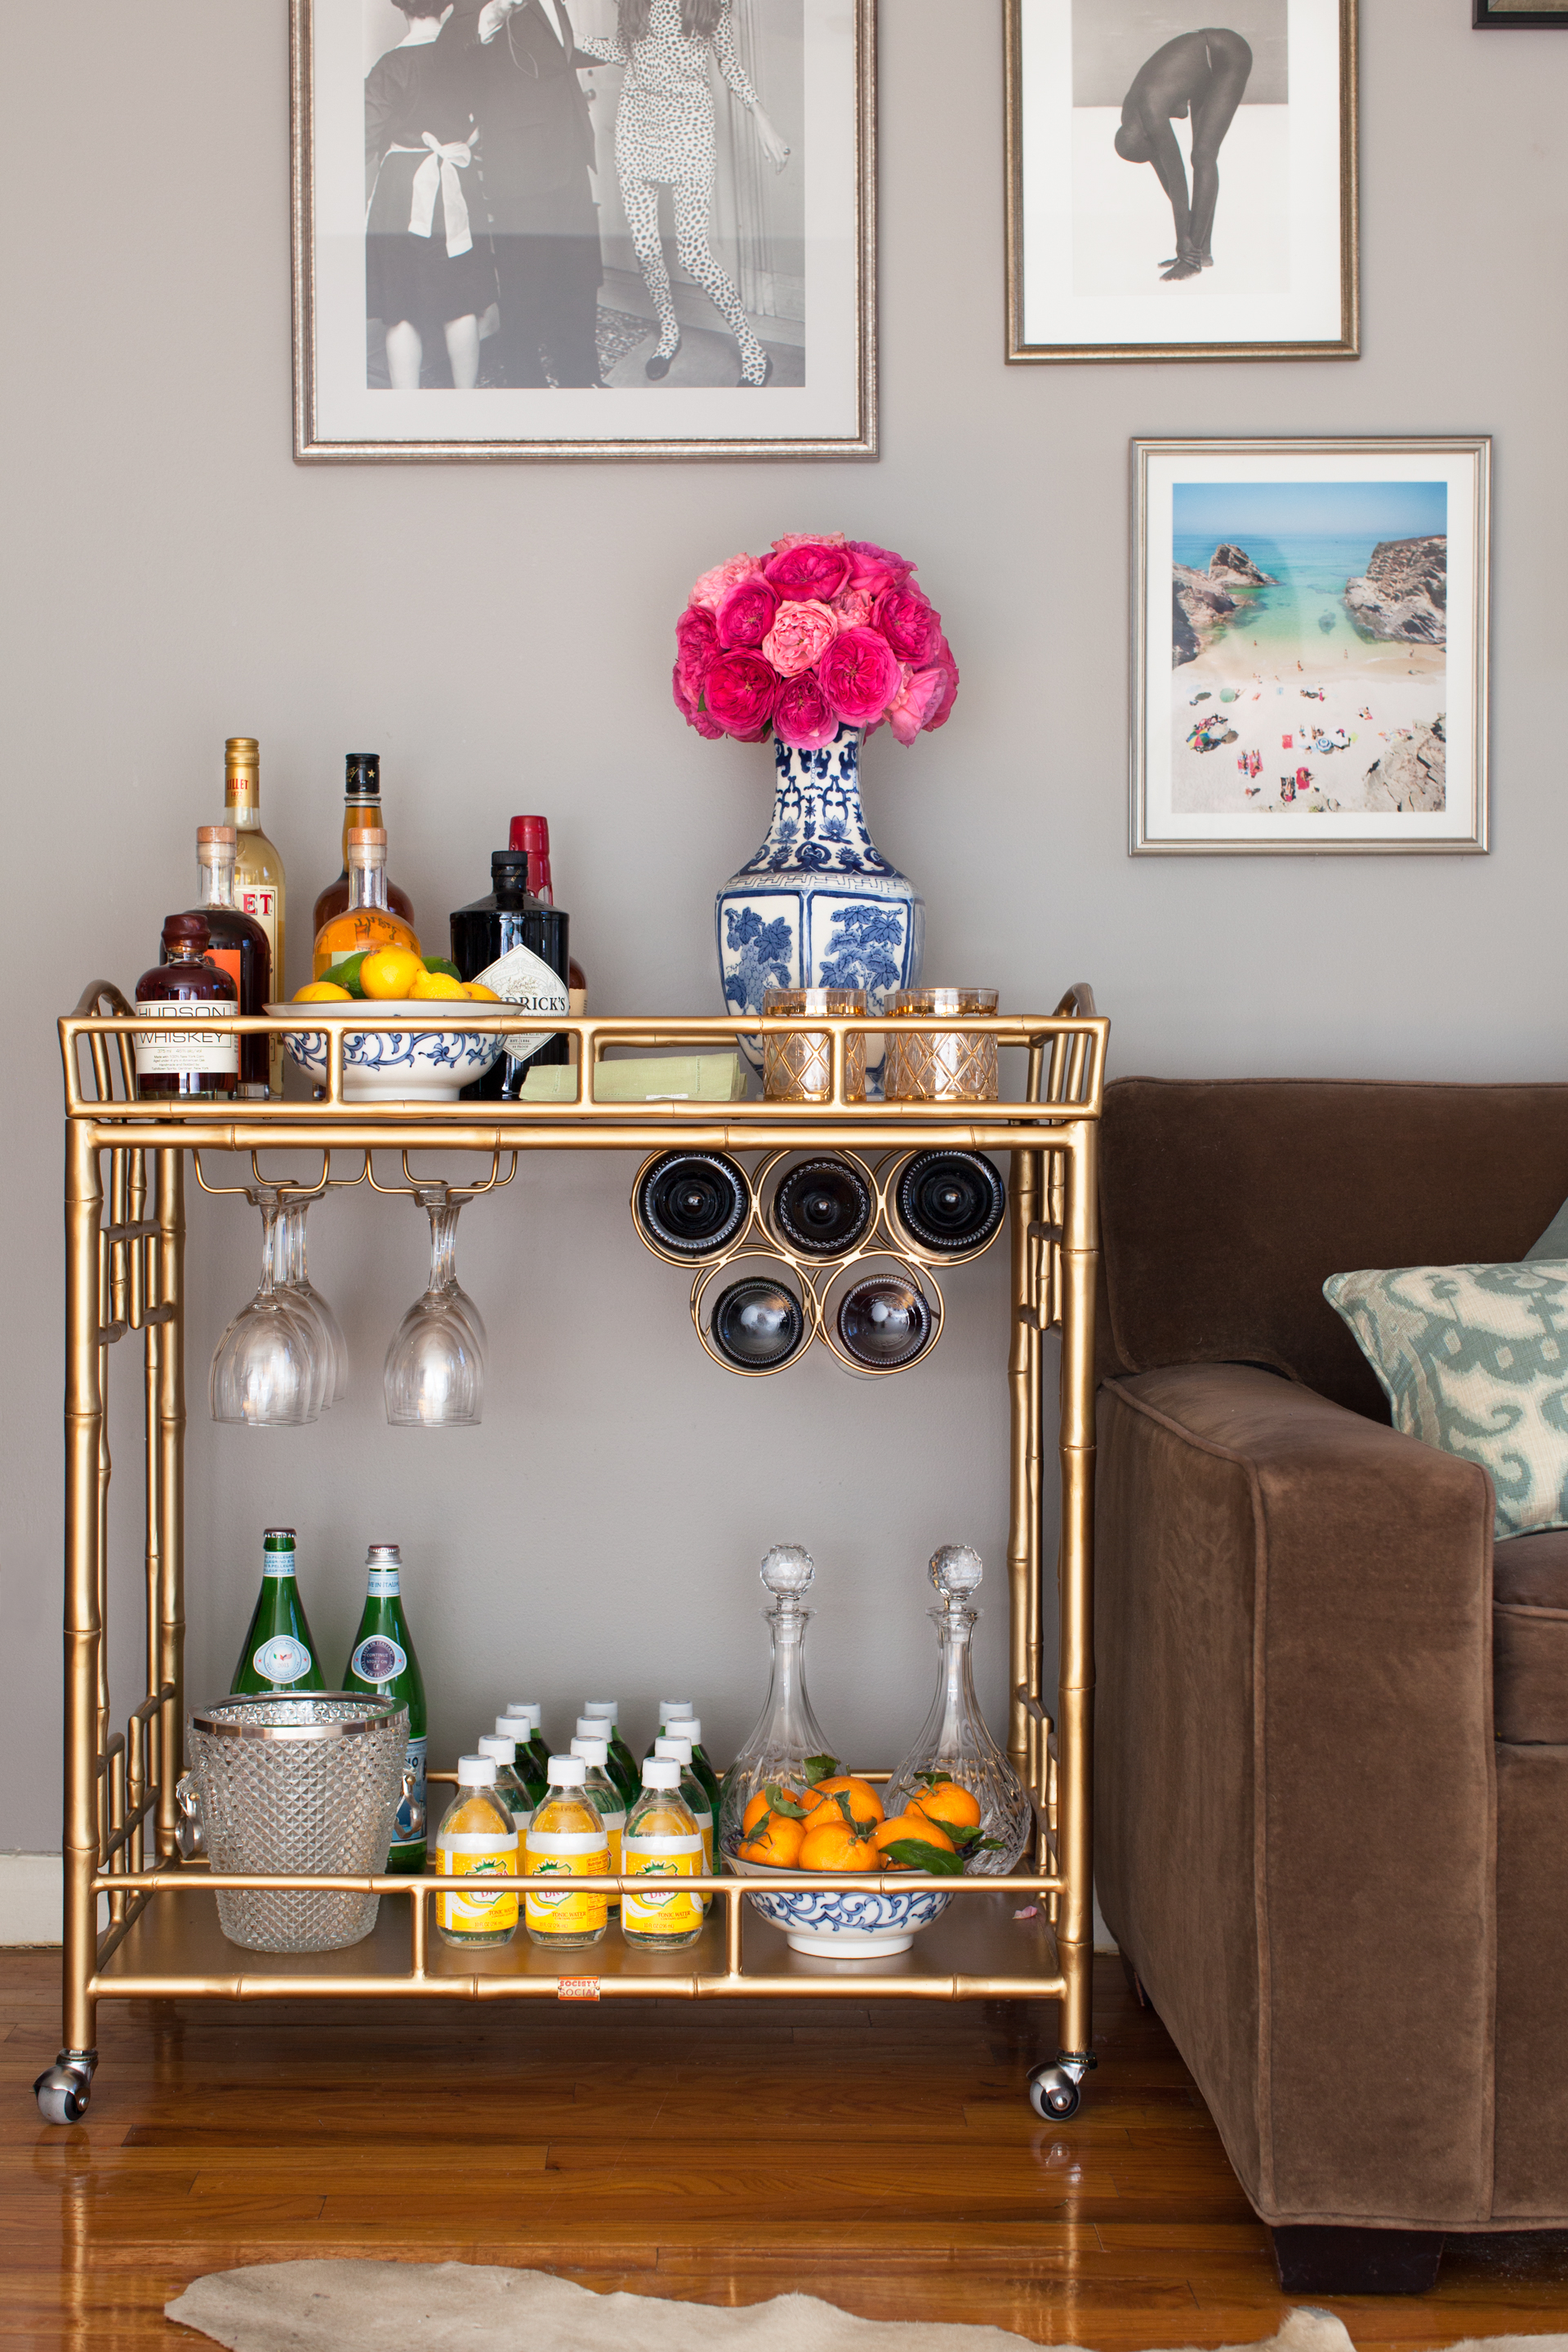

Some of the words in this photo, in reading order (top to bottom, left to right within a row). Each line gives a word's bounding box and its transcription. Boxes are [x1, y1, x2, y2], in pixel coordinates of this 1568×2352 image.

[242, 893, 274, 915] ET
[138, 1007, 225, 1017] HUDSON
[140, 1032, 223, 1044] WHISKEY
